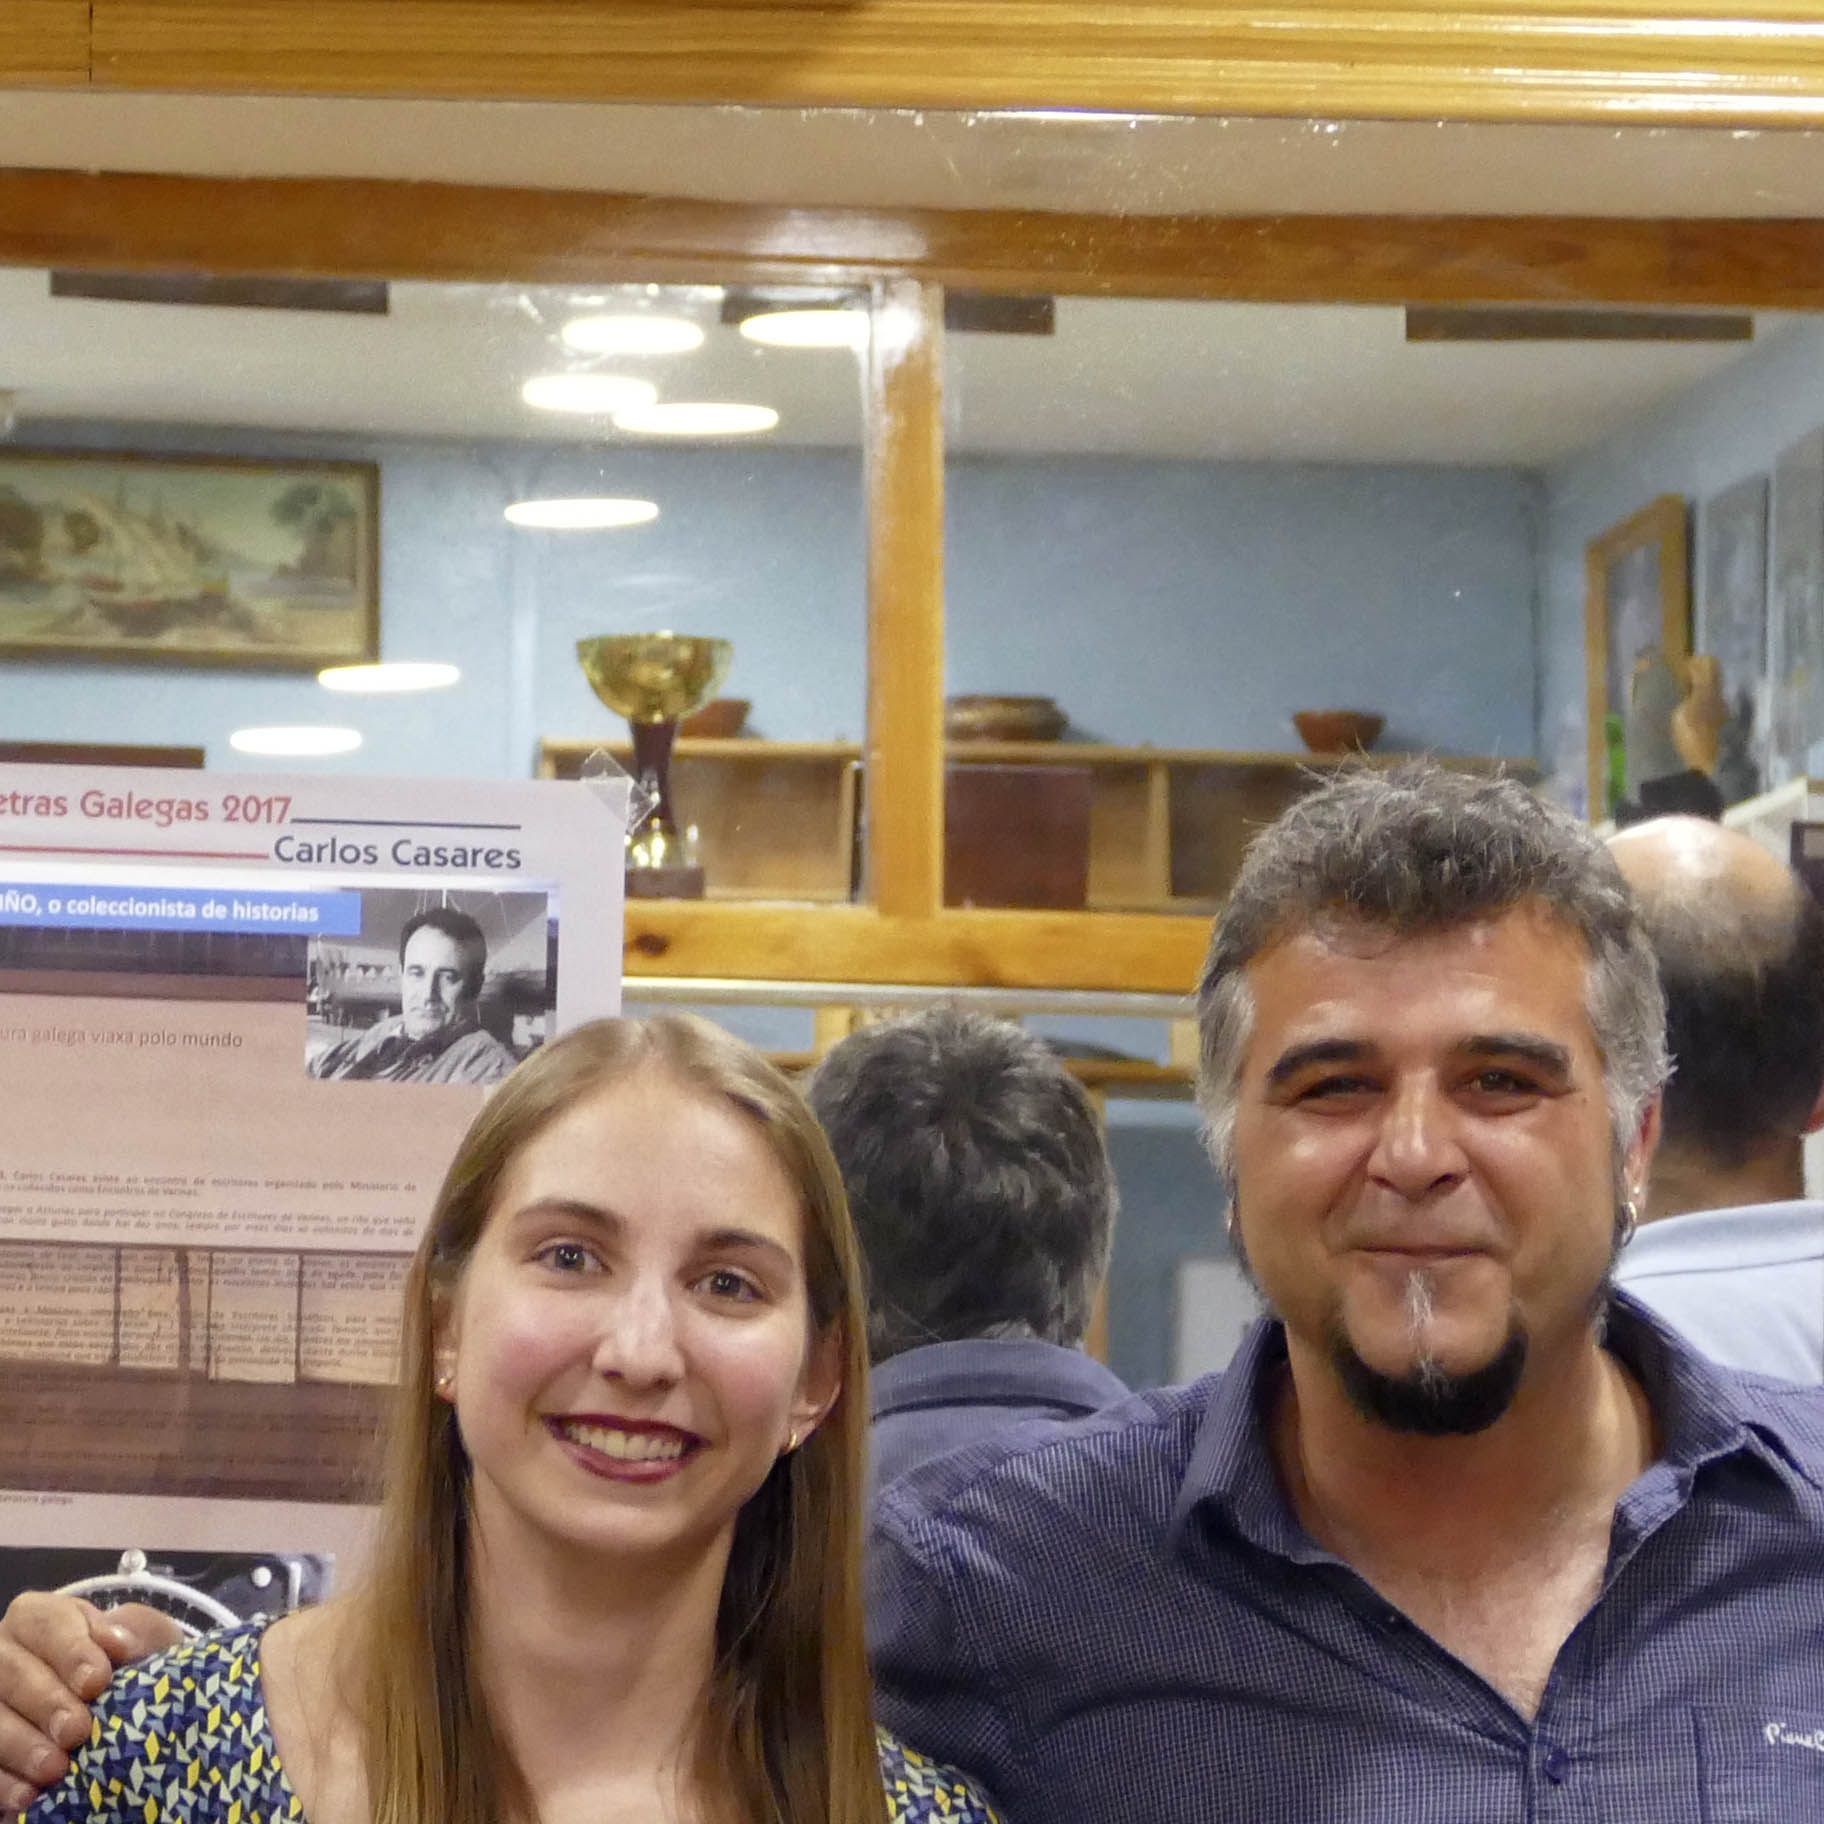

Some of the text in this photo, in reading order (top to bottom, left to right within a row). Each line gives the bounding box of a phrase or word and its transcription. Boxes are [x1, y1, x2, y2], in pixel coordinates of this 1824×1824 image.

[80, 790, 209, 828] Galegas
[222, 794, 292, 824] 2017
[275, 835, 522, 869] Carlos Casares
[48, 899, 61, 915] o
[67, 896, 196, 919] coleccionista
[201, 899, 227, 919] de
[233, 900, 320, 922] historias
[31, 1026, 87, 1047] galega
[90, 1029, 134, 1044] viaxa
[139, 1028, 178, 1047] polo
[182, 1031, 243, 1048] mundo
